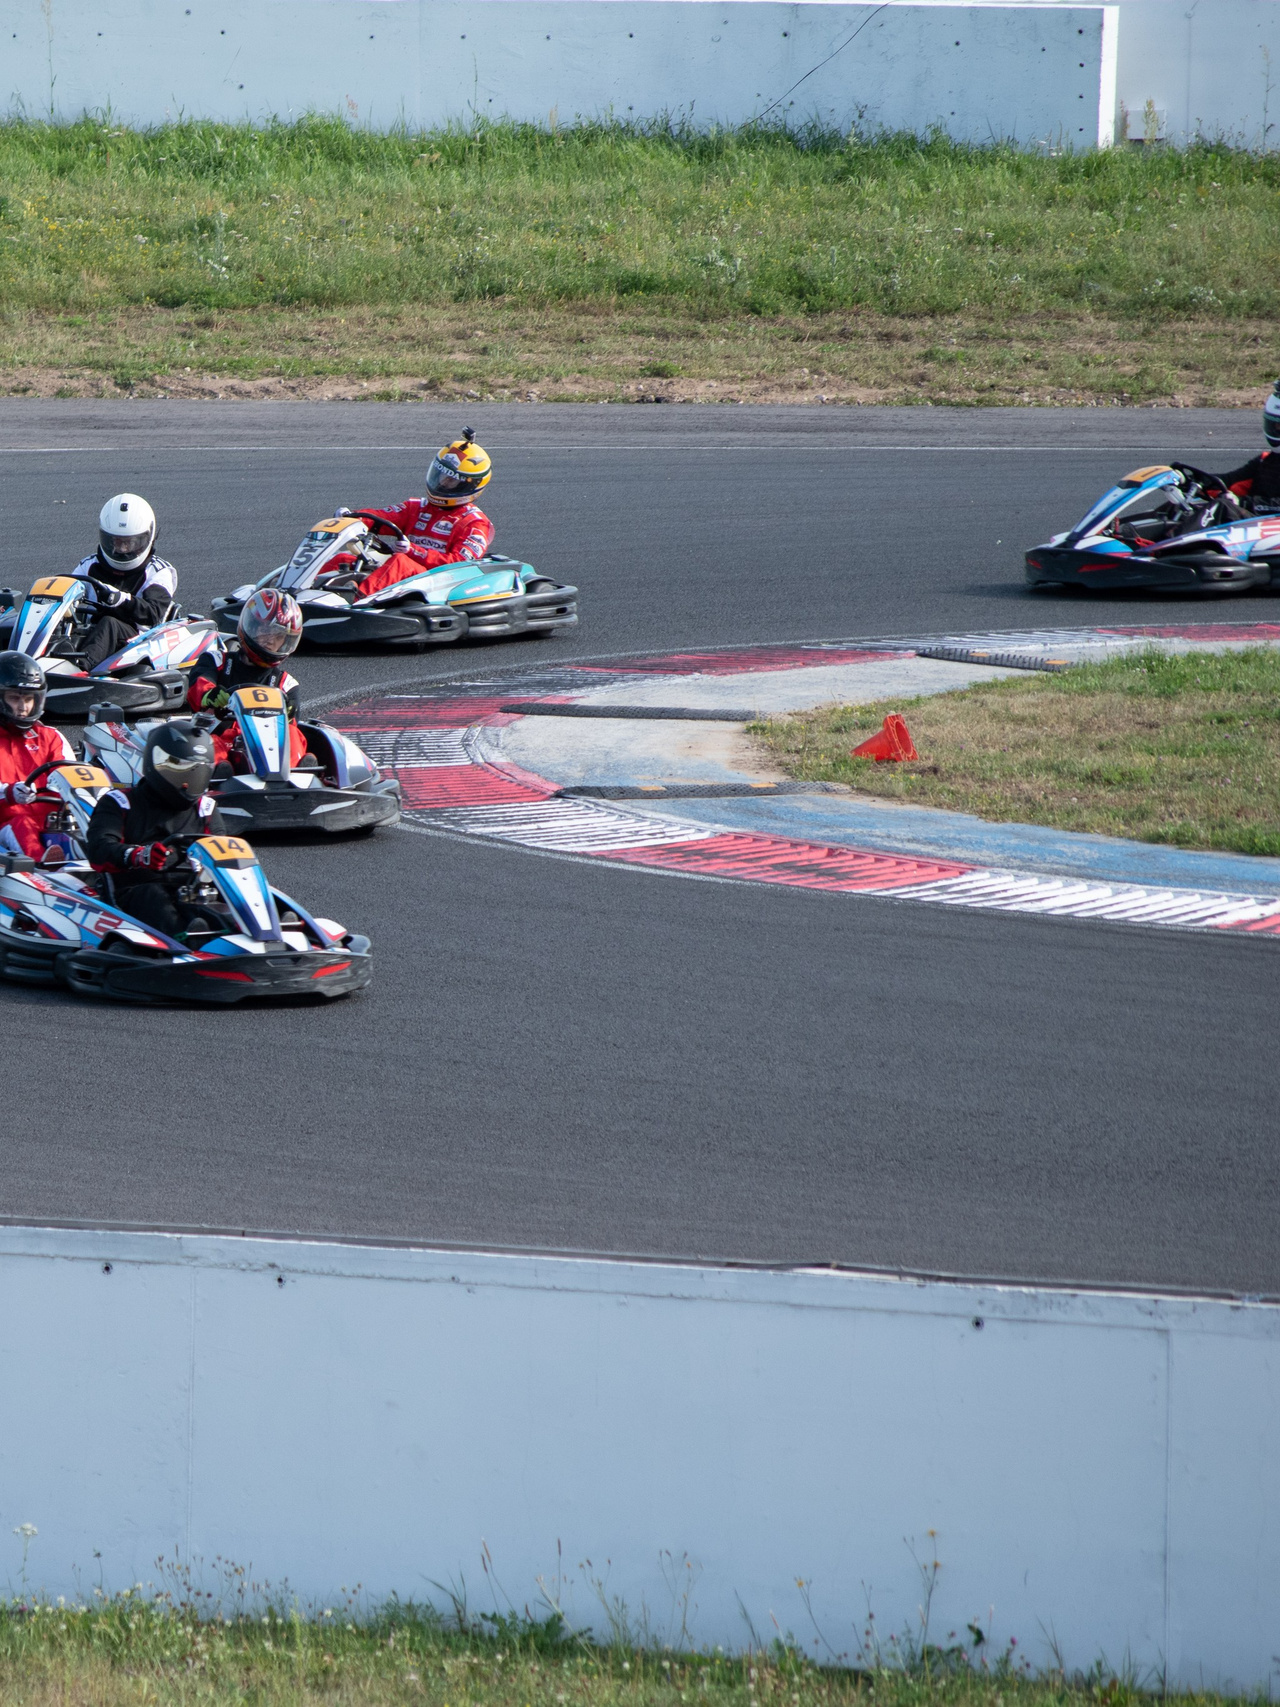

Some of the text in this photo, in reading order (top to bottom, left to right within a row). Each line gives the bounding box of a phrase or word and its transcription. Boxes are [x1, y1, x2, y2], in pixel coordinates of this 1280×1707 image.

[433, 460, 461, 480] HONDA
[293, 548, 319, 567] 5
[44, 578, 58, 590] 1
[251, 688, 269, 702] 6
[74, 767, 95, 781] 9
[208, 838, 245, 854] 14
